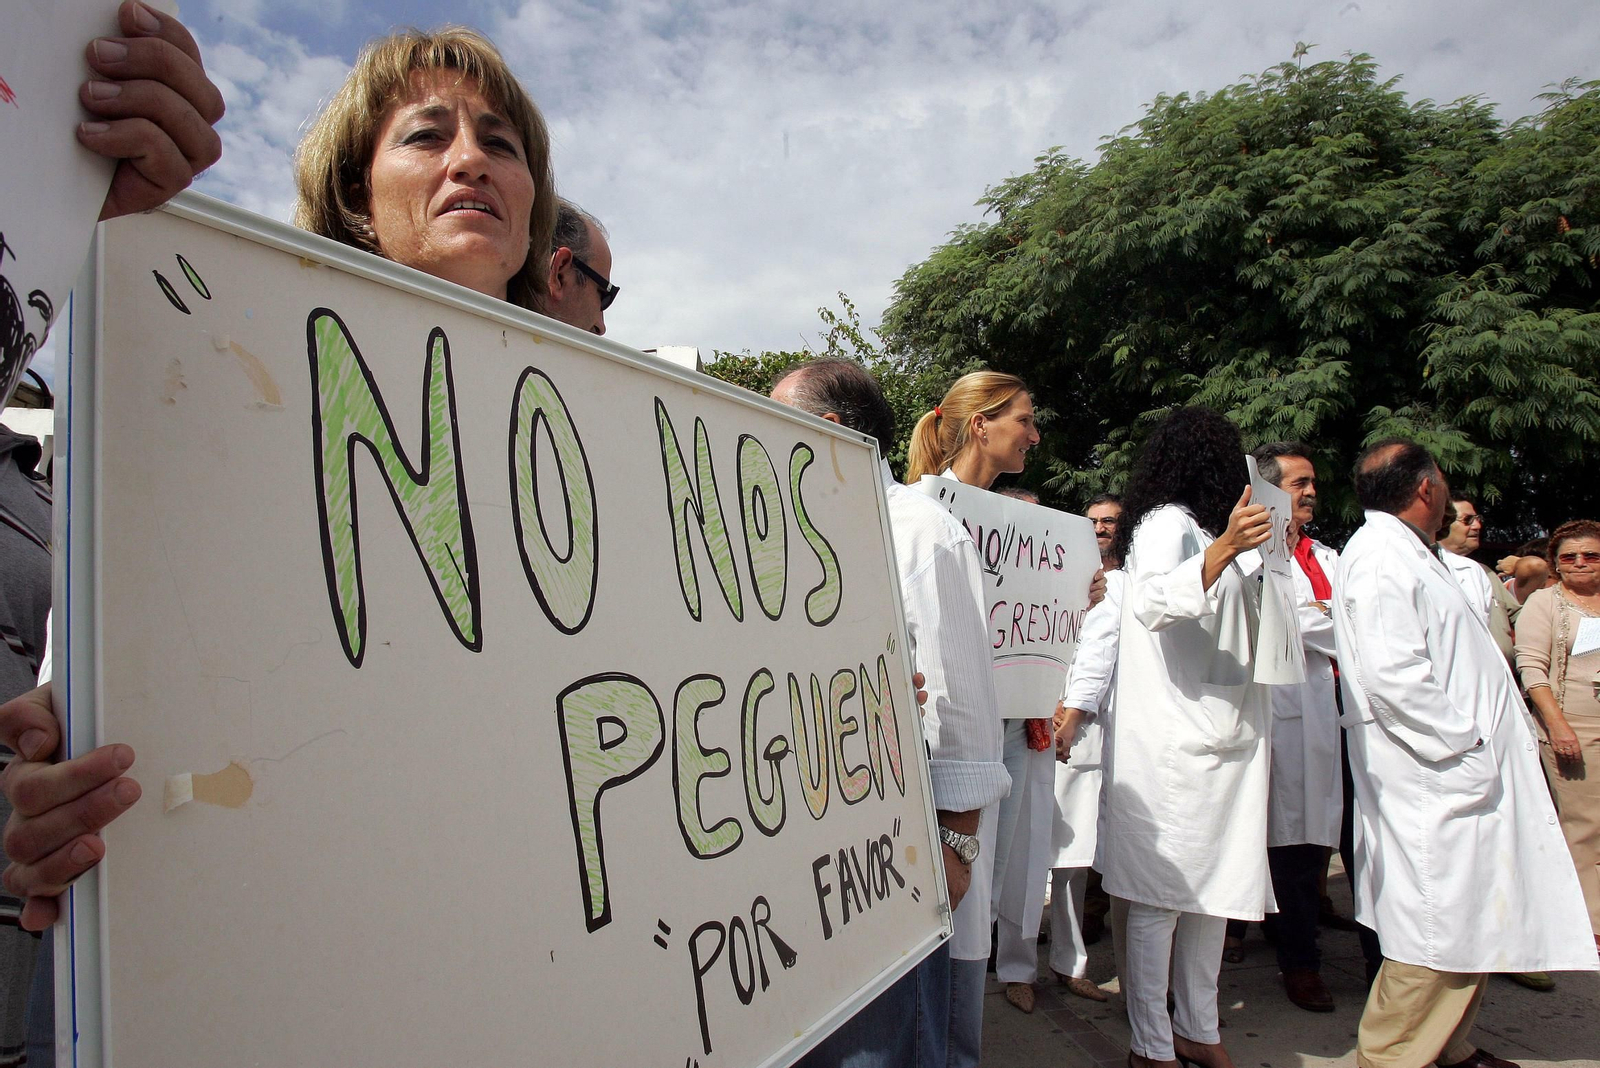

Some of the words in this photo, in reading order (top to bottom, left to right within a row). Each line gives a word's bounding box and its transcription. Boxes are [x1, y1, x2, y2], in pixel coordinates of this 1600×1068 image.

[307, 307, 599, 669] NO
[654, 396, 843, 627] NOS
[1016, 529, 1067, 573] MÁS
[989, 599, 1088, 649] GRESIONE
